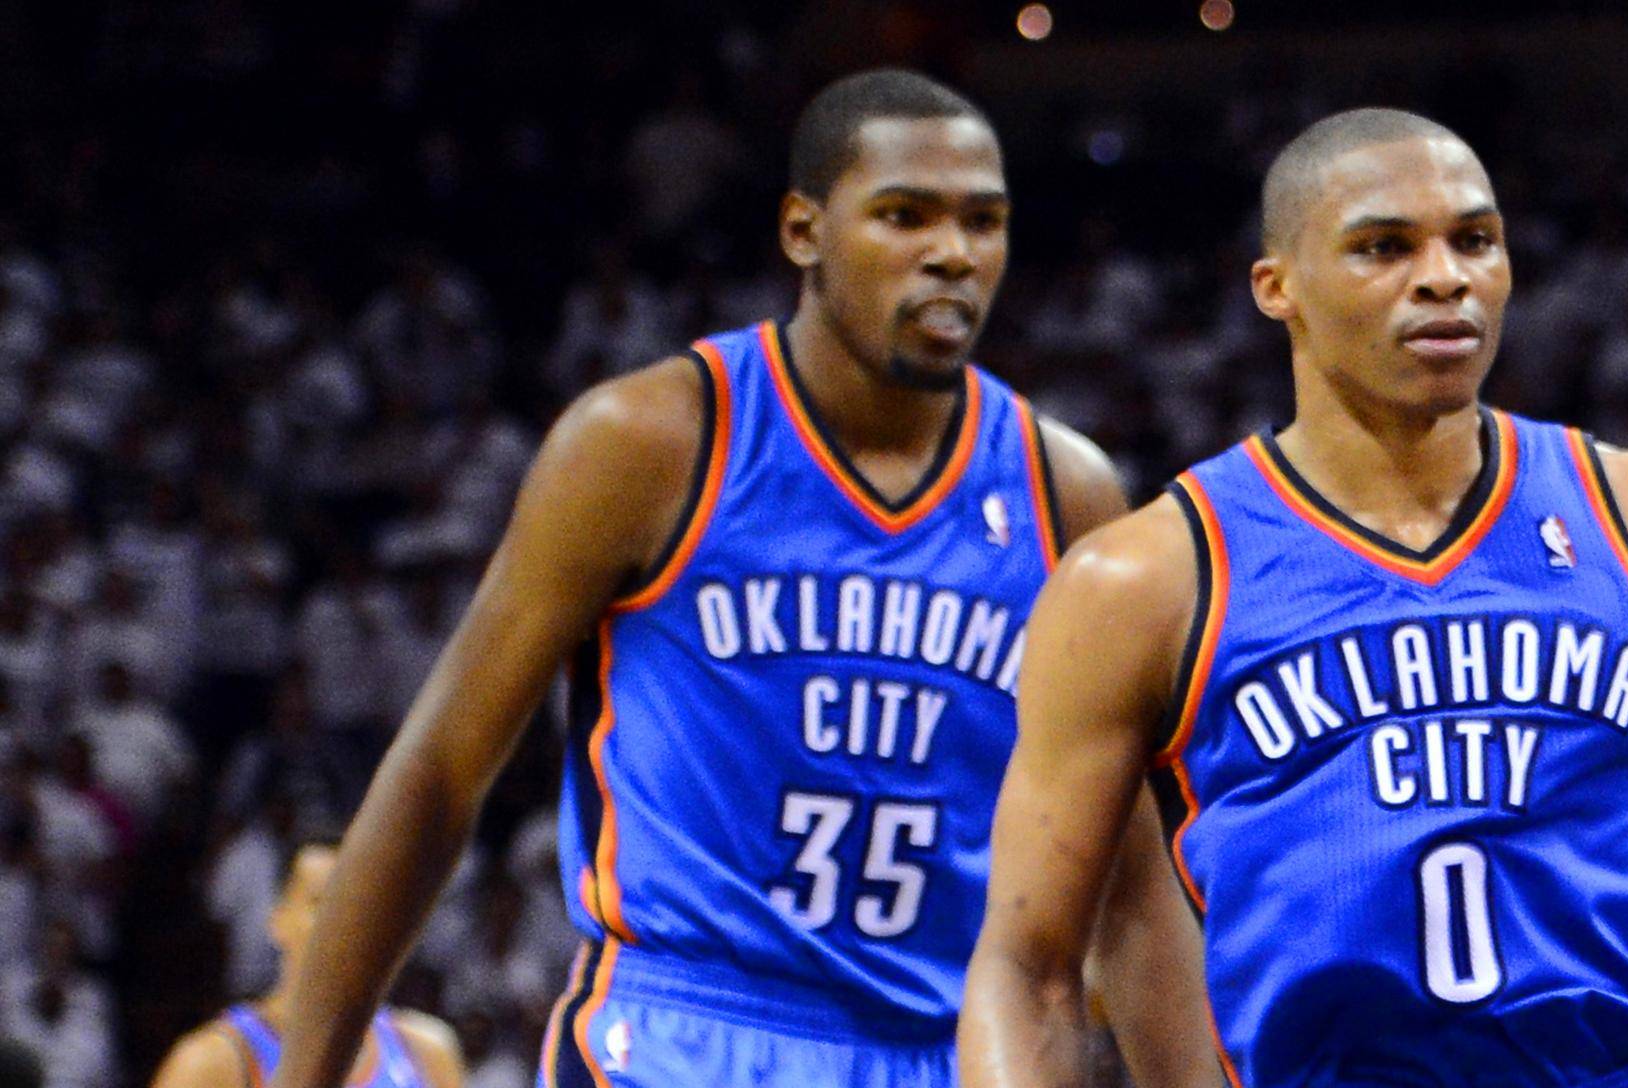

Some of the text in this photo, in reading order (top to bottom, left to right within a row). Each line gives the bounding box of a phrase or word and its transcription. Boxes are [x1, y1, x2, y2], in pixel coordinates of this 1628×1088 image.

[803, 676, 947, 764] CITY
[1371, 719, 1541, 808] CITY
[769, 792, 937, 938] 35
[1420, 842, 1501, 1004] 0
